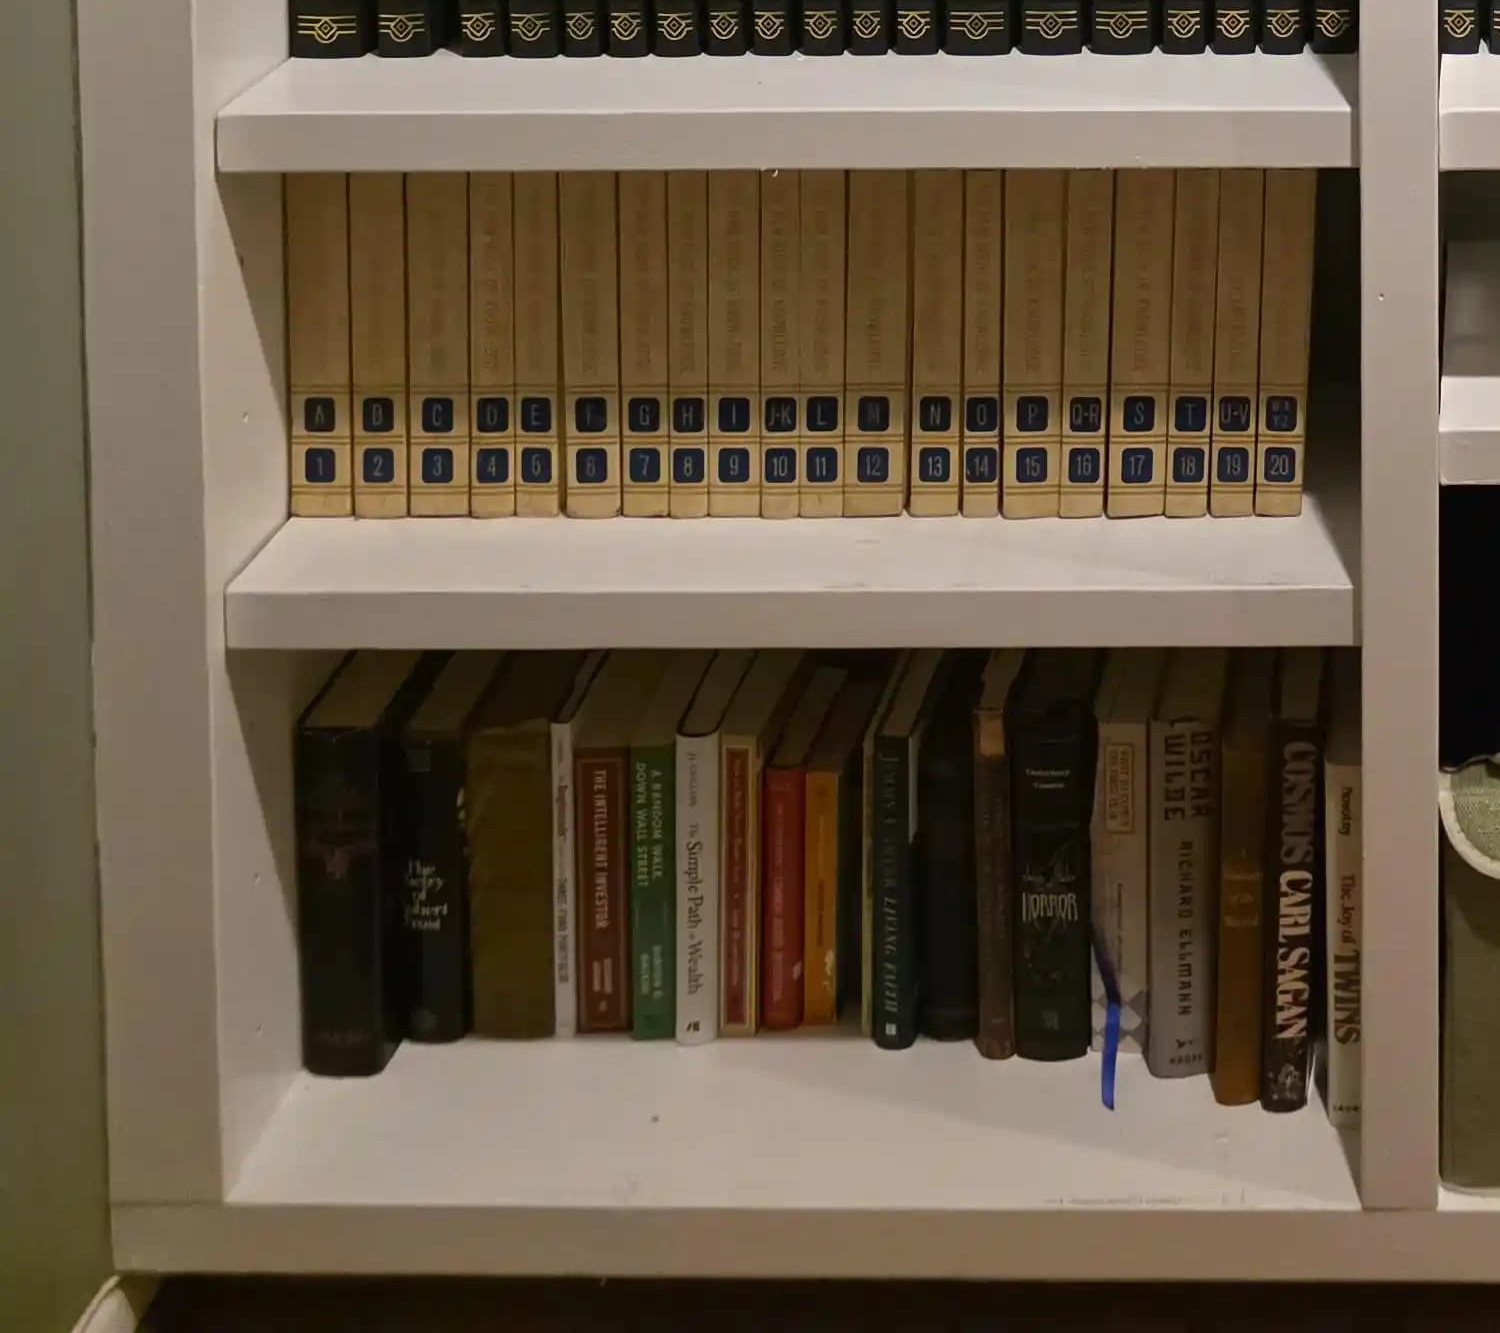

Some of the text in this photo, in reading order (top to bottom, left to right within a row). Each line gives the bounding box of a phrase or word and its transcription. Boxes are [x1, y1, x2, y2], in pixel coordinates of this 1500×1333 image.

[372, 405, 384, 424] B
[431, 404, 443, 427] C
[530, 404, 540, 425] E
[639, 404, 650, 425] G
[682, 404, 694, 425] H
[816, 404, 826, 425] L
[929, 405, 941, 425] N
[1027, 405, 1038, 425] P
[1133, 402, 1145, 425] S
[1184, 404, 1196, 425] T
[315, 456, 324, 476] 1
[372, 456, 384, 477] 2
[431, 455, 444, 477] 3
[485, 455, 498, 477] 4
[530, 453, 542, 476] 5
[639, 455, 650, 477] 7
[682, 455, 694, 476] 8
[728, 455, 739, 476] 9
[772, 455, 789, 477] 10
[814, 455, 827, 476] 11
[864, 453, 881, 475] 12
[927, 454, 943, 475] 13
[972, 454, 990, 474] 14
[1024, 454, 1041, 474] 15
[1075, 454, 1092, 474] 16
[1129, 454, 1146, 475] 17
[1180, 454, 1197, 475] 18
[1225, 454, 1242, 474] 19
[1269, 454, 1289, 476] 20
[1163, 734, 1187, 822] WILDE
[1189, 731, 1212, 818] OSCAR
[635, 760, 649, 887] DOWN WALL STREET
[650, 769, 664, 881] A RANDOM WALK
[592, 769, 611, 930] THE INTELLIGENT INVESTOR
[682, 840, 703, 892] Simple
[1274, 740, 1317, 1041] COSMOS CARL SAGAN
[686, 895, 703, 930] Path
[1021, 892, 1080, 923] HORROR
[1177, 840, 1194, 1017] RICHARD ELLMANN
[687, 941, 702, 994] Wealth
[1333, 874, 1361, 1046] The Joy of TWINS
